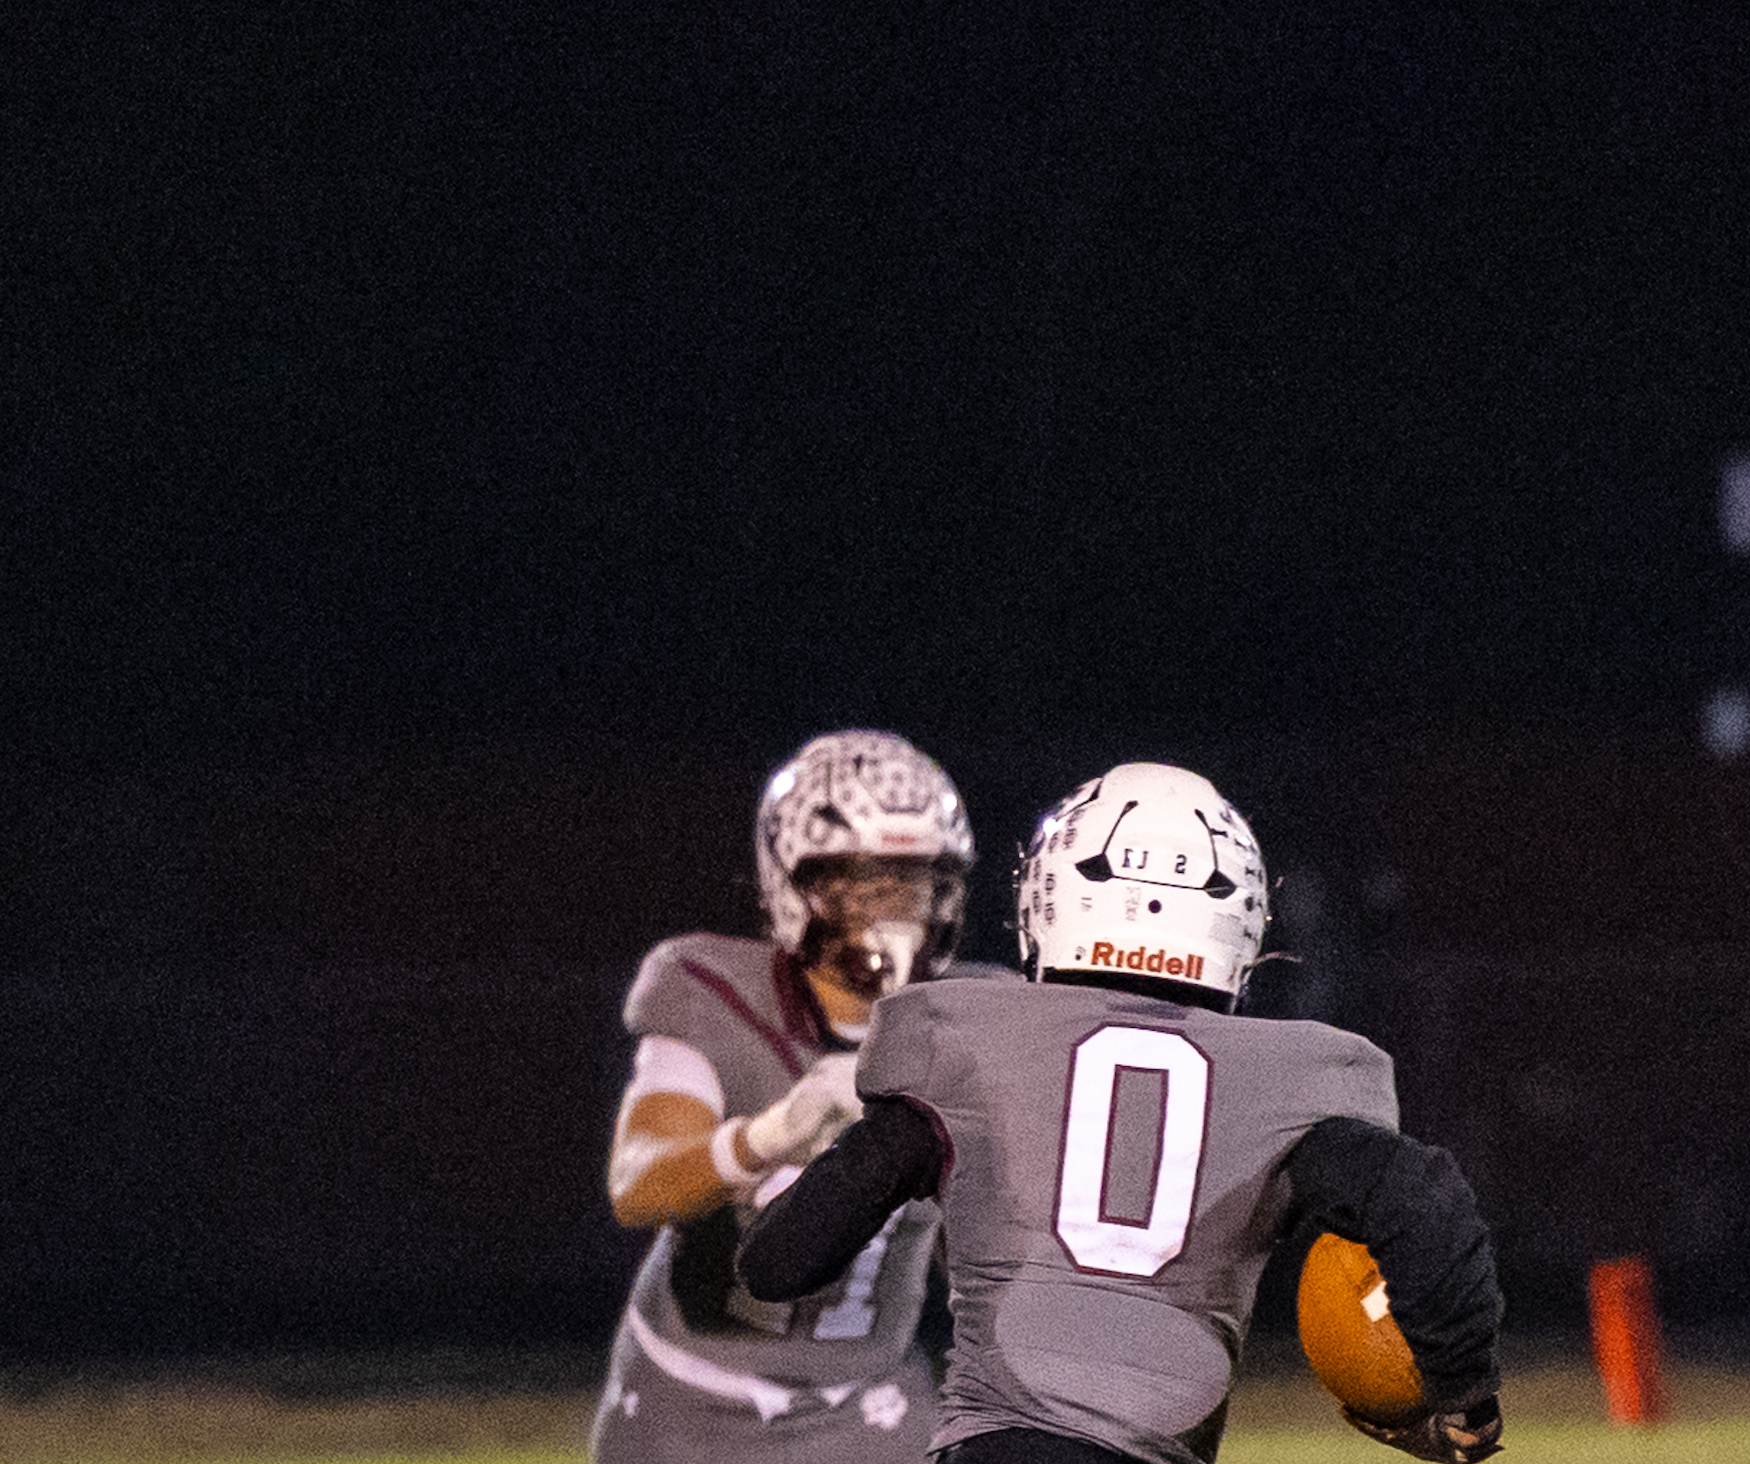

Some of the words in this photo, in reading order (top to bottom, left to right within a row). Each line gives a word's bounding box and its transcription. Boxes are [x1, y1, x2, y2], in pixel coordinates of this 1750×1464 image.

[1174, 854, 1187, 874] 2
[1090, 941, 1204, 980] Riddell
[1051, 1022, 1213, 1278] 0
